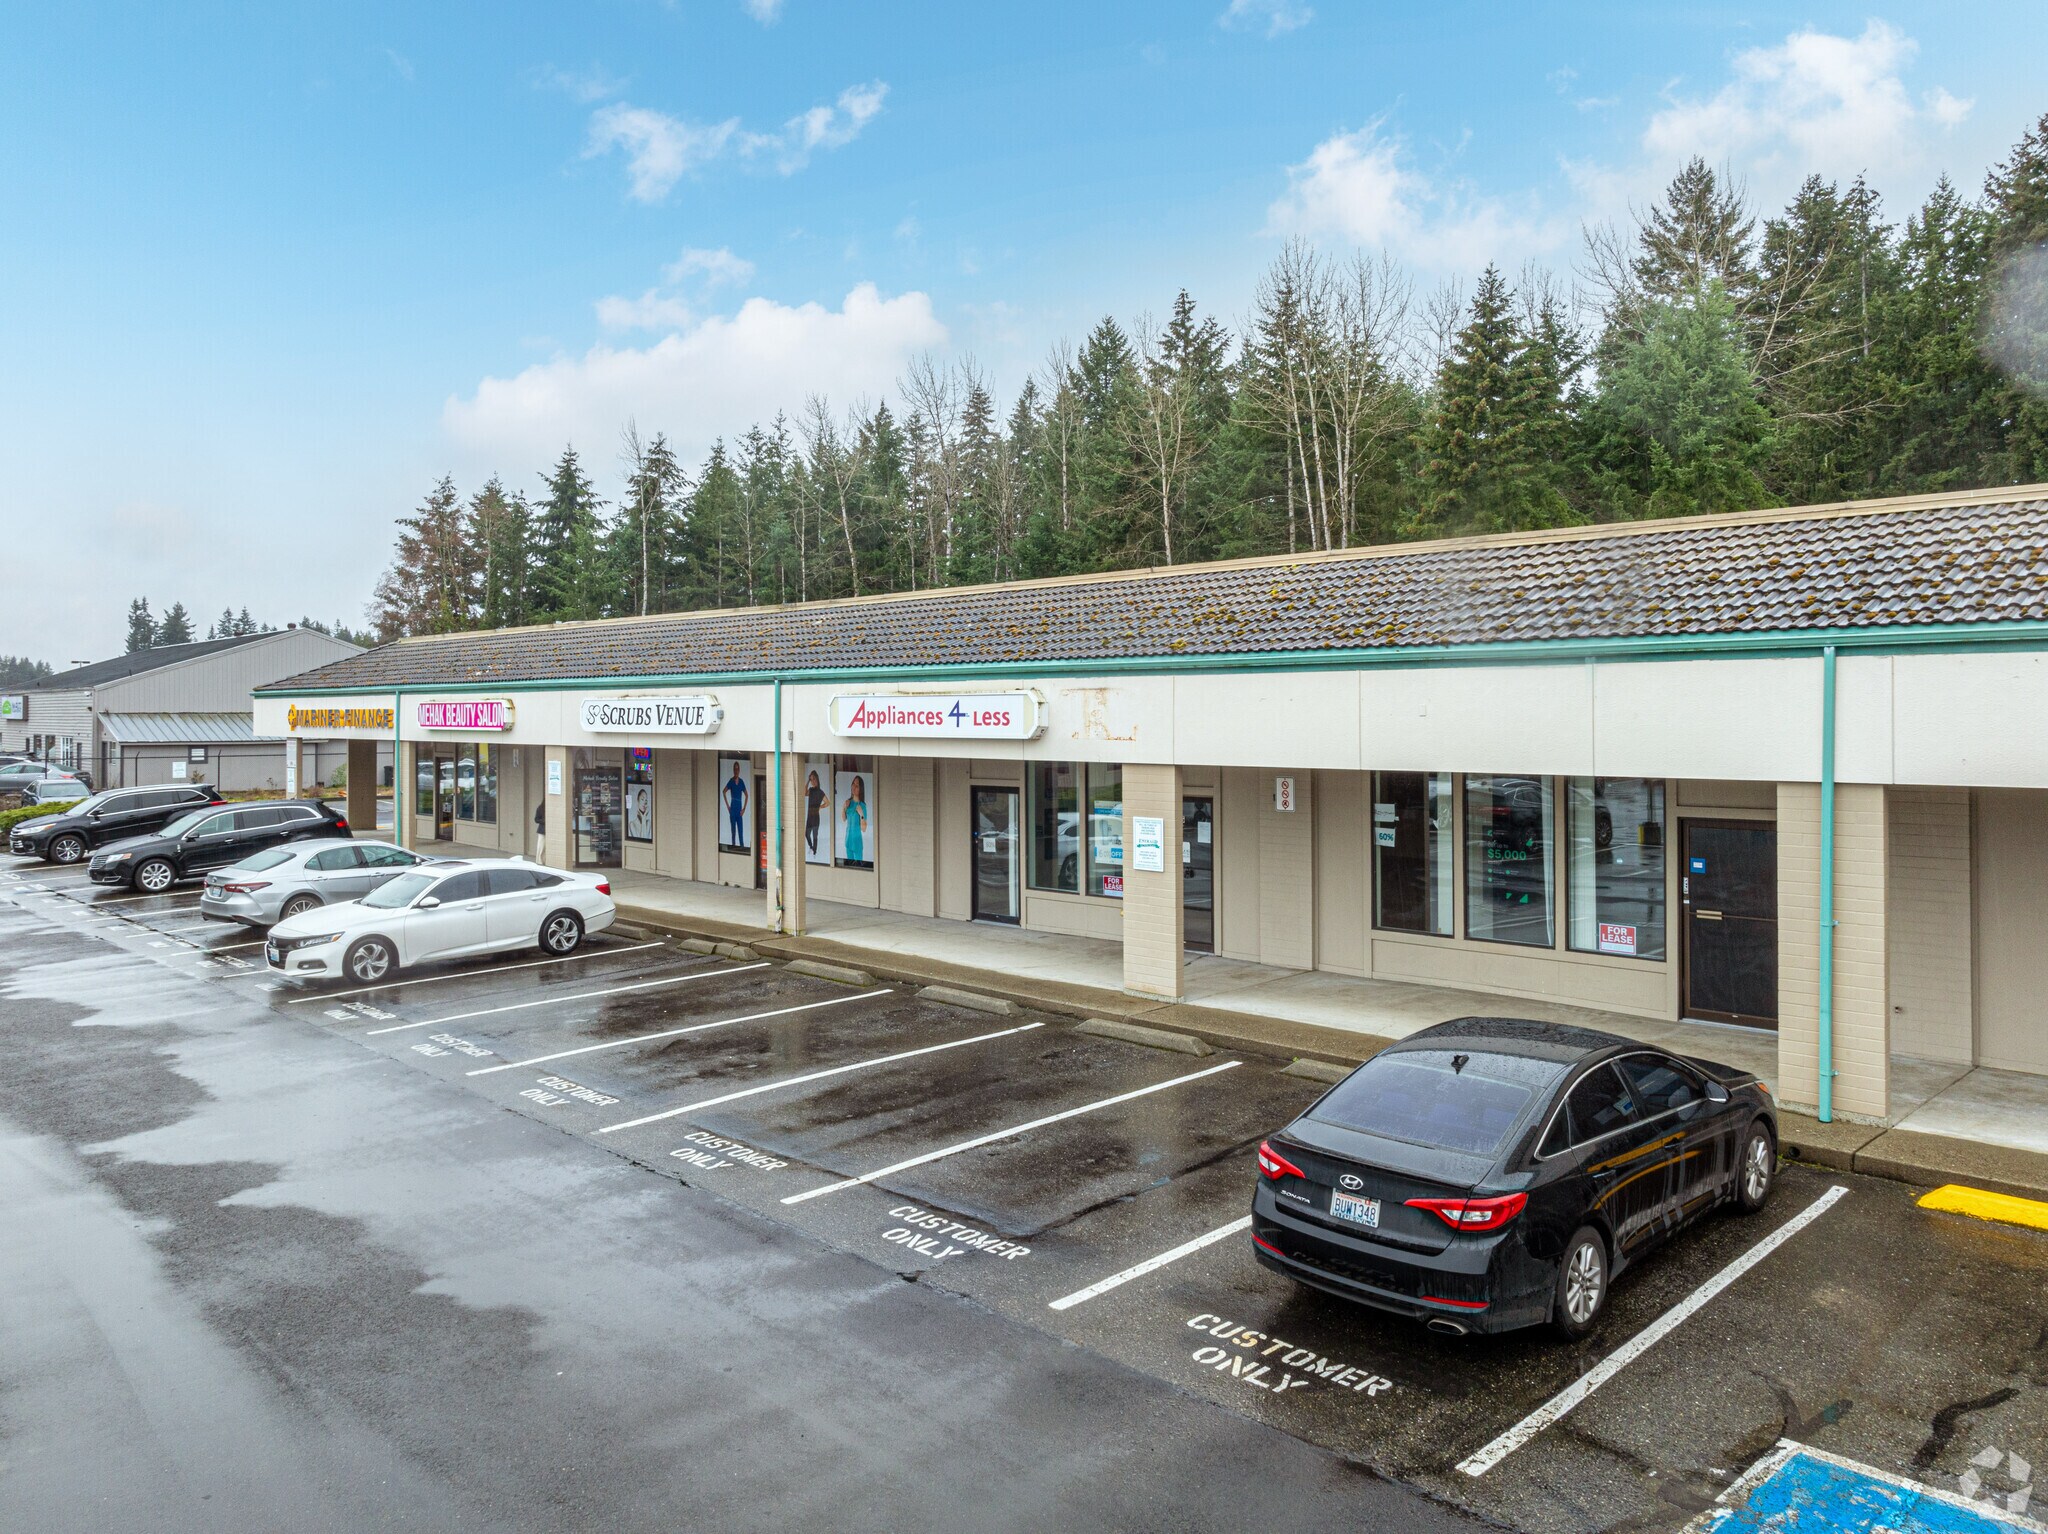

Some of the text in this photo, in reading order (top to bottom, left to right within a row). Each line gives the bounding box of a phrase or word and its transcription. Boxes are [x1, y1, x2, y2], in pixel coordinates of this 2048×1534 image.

[297, 709, 394, 729] MARINER FINANCE
[420, 703, 504, 728] MEHAK BEAUTY SALON
[600, 704, 705, 726] SCRUBS VENUE
[847, 699, 1010, 729] Appliances 4 Less
[1487, 848, 1527, 861] $5,000
[1104, 883, 1123, 891] LEASE
[1602, 933, 1634, 945] LEASE
[1607, 926, 1627, 936] FOR
[410, 1043, 453, 1058] ONLY
[428, 1033, 494, 1058] CUSTOMER
[519, 1088, 571, 1107] ONLY
[536, 1076, 620, 1107] CUSTOMER
[669, 1148, 734, 1170] ONLY
[683, 1131, 788, 1171] CUSTOMER
[1280, 1189, 1311, 1204] SONATA
[1334, 1197, 1377, 1221] BUW1348
[881, 1228, 965, 1259] ONLY
[888, 1205, 1031, 1260] CUSTOMER
[1186, 1313, 1393, 1397] CUSTOMER
[1192, 1346, 1309, 1393] ONLY
